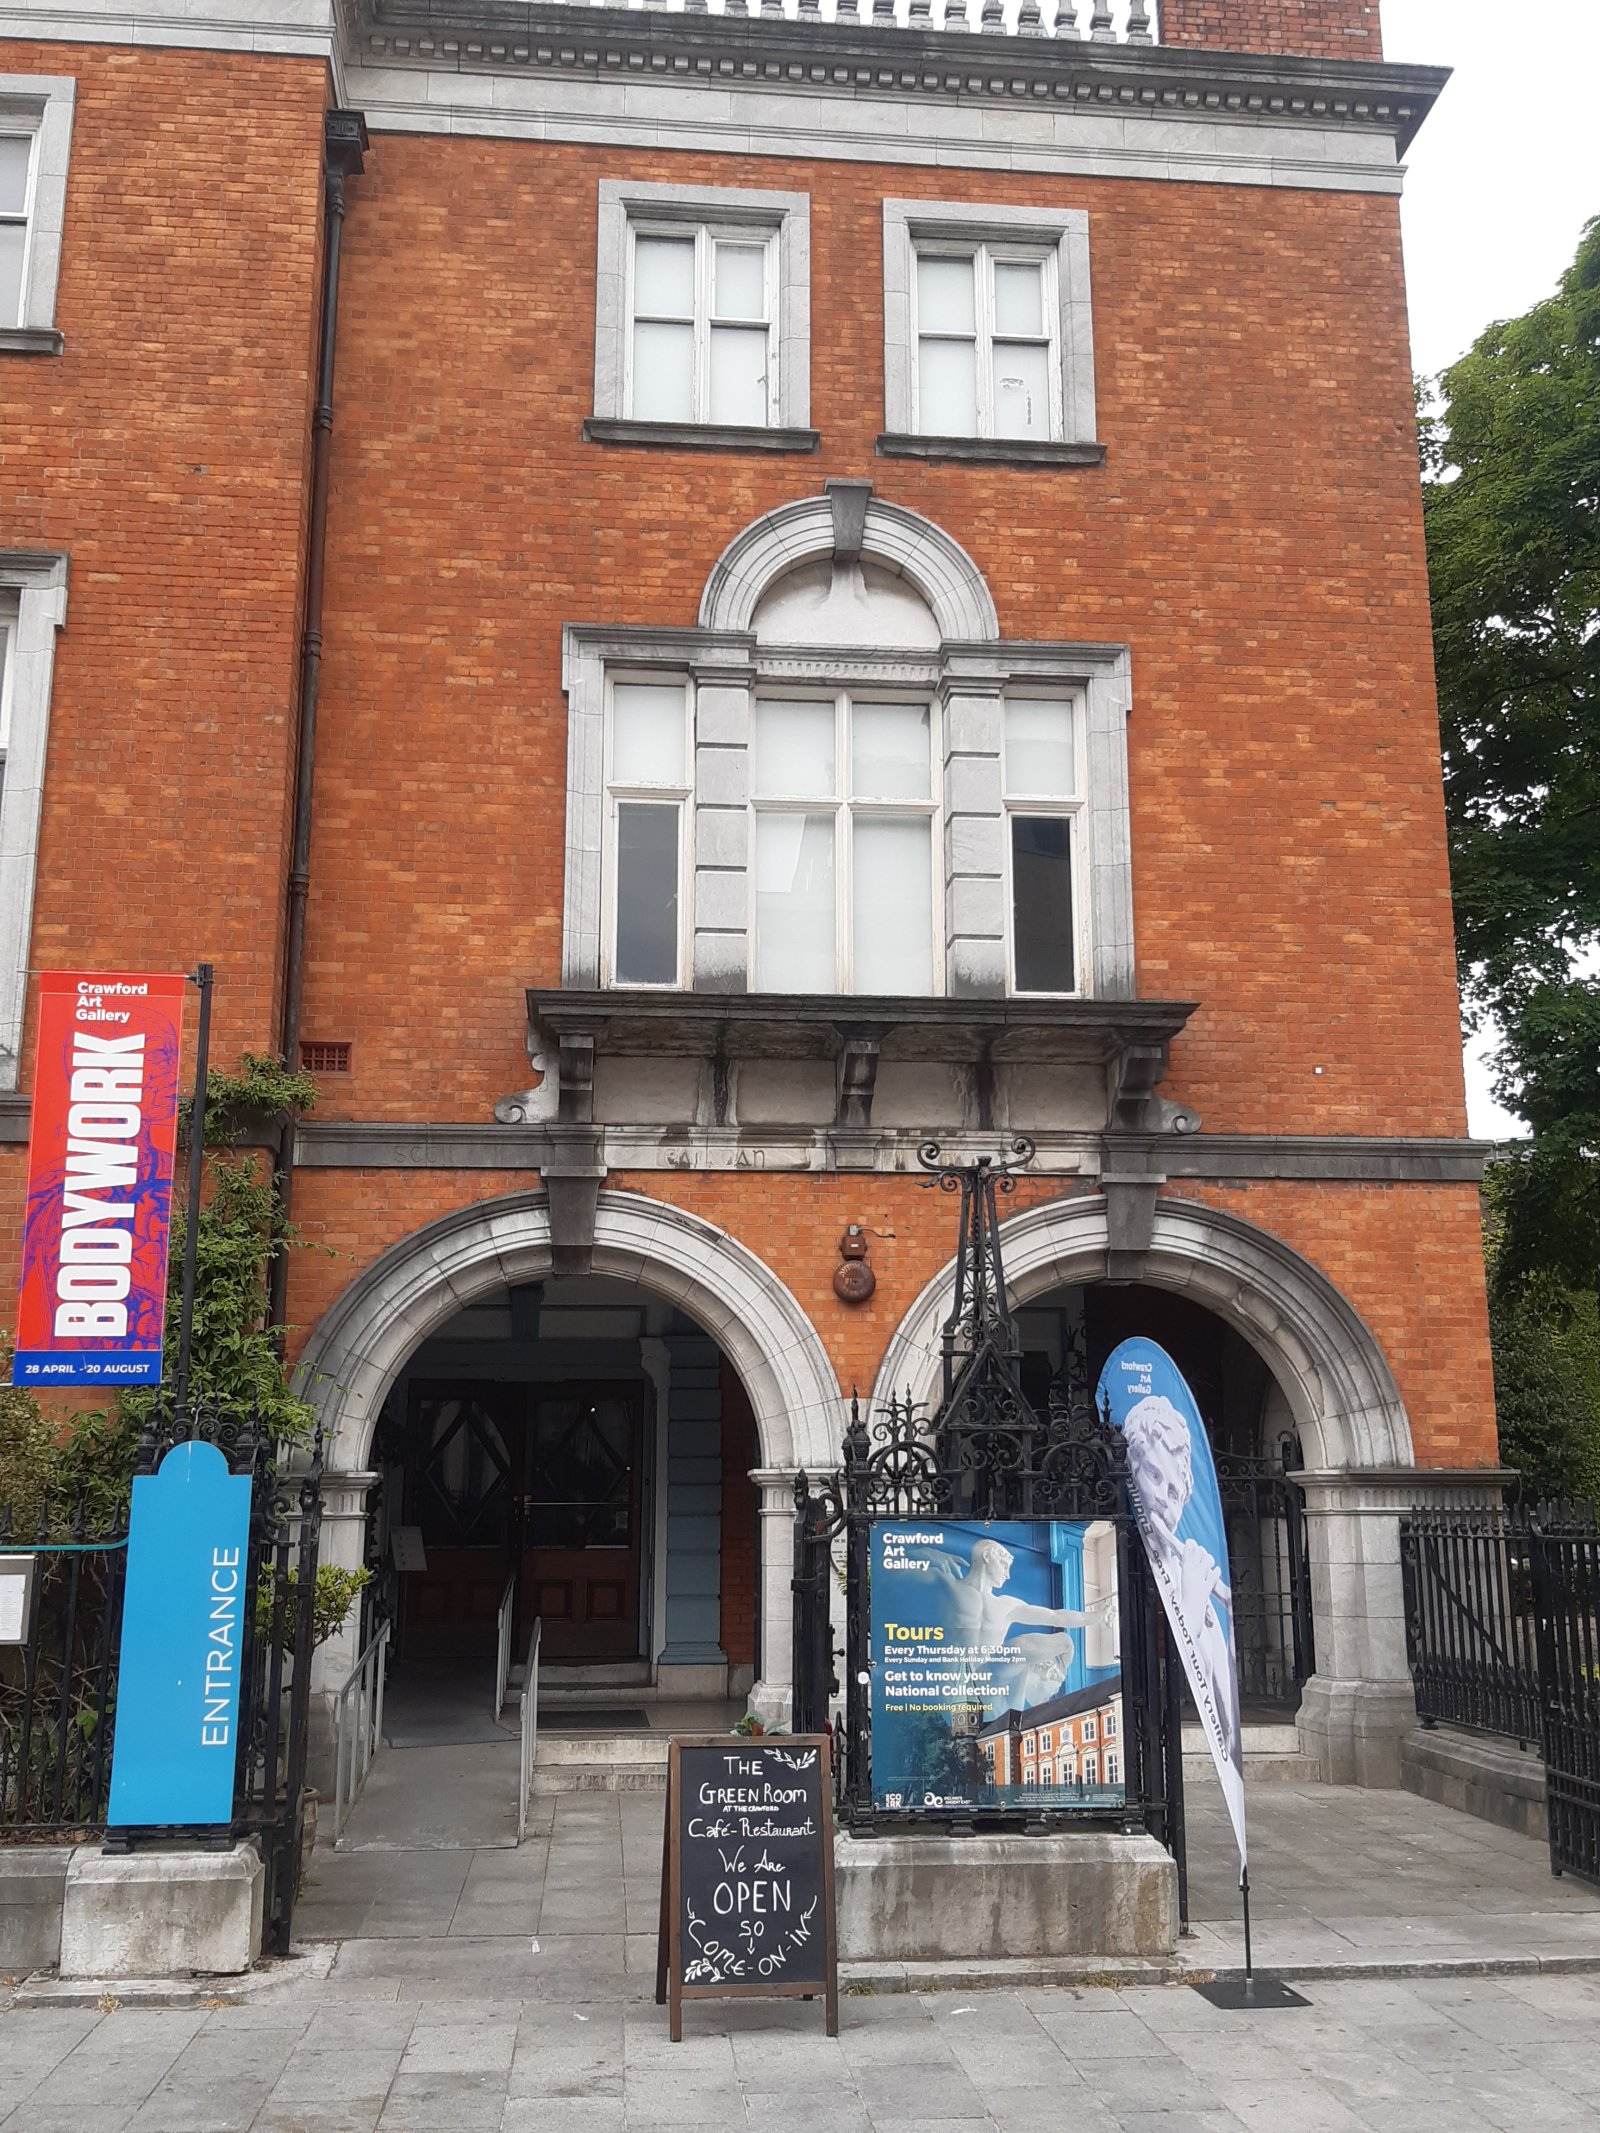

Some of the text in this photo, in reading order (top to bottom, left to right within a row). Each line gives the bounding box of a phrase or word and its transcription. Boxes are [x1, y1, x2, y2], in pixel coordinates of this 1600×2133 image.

[77, 982, 148, 995] Crawford
[76, 996, 103, 1007] Art
[76, 1008, 130, 1023] Gallery
[54, 1031, 146, 1337] BODYWORK
[25, 1364, 40, 1374] 28
[42, 1365, 76, 1374] APRIL
[86, 1364, 100, 1374] 20
[103, 1364, 150, 1373] AUGUST
[882, 1532, 944, 1544] Crawford
[883, 1545, 906, 1556] Art
[882, 1558, 930, 1572] Gallery
[884, 1623, 944, 1640] Tours
[202, 1546, 239, 1746] ENTRANCE
[884, 1645, 1022, 1656] Every Thursday at 6:30pm
[904, 1656, 928, 1664] Sunday
[960, 1656, 984, 1664] Holiday
[985, 1656, 1011, 1664] Monday
[884, 1670, 993, 1684] Get to know your
[885, 1684, 1010, 1696] National Collection!
[922, 1704, 957, 1712] booking
[958, 1703, 993, 1712] required
[723, 1756, 764, 1776] THE
[699, 1782, 759, 1804] GREEN
[718, 1844, 748, 1873] We
[713, 1879, 791, 1915] OPEN
